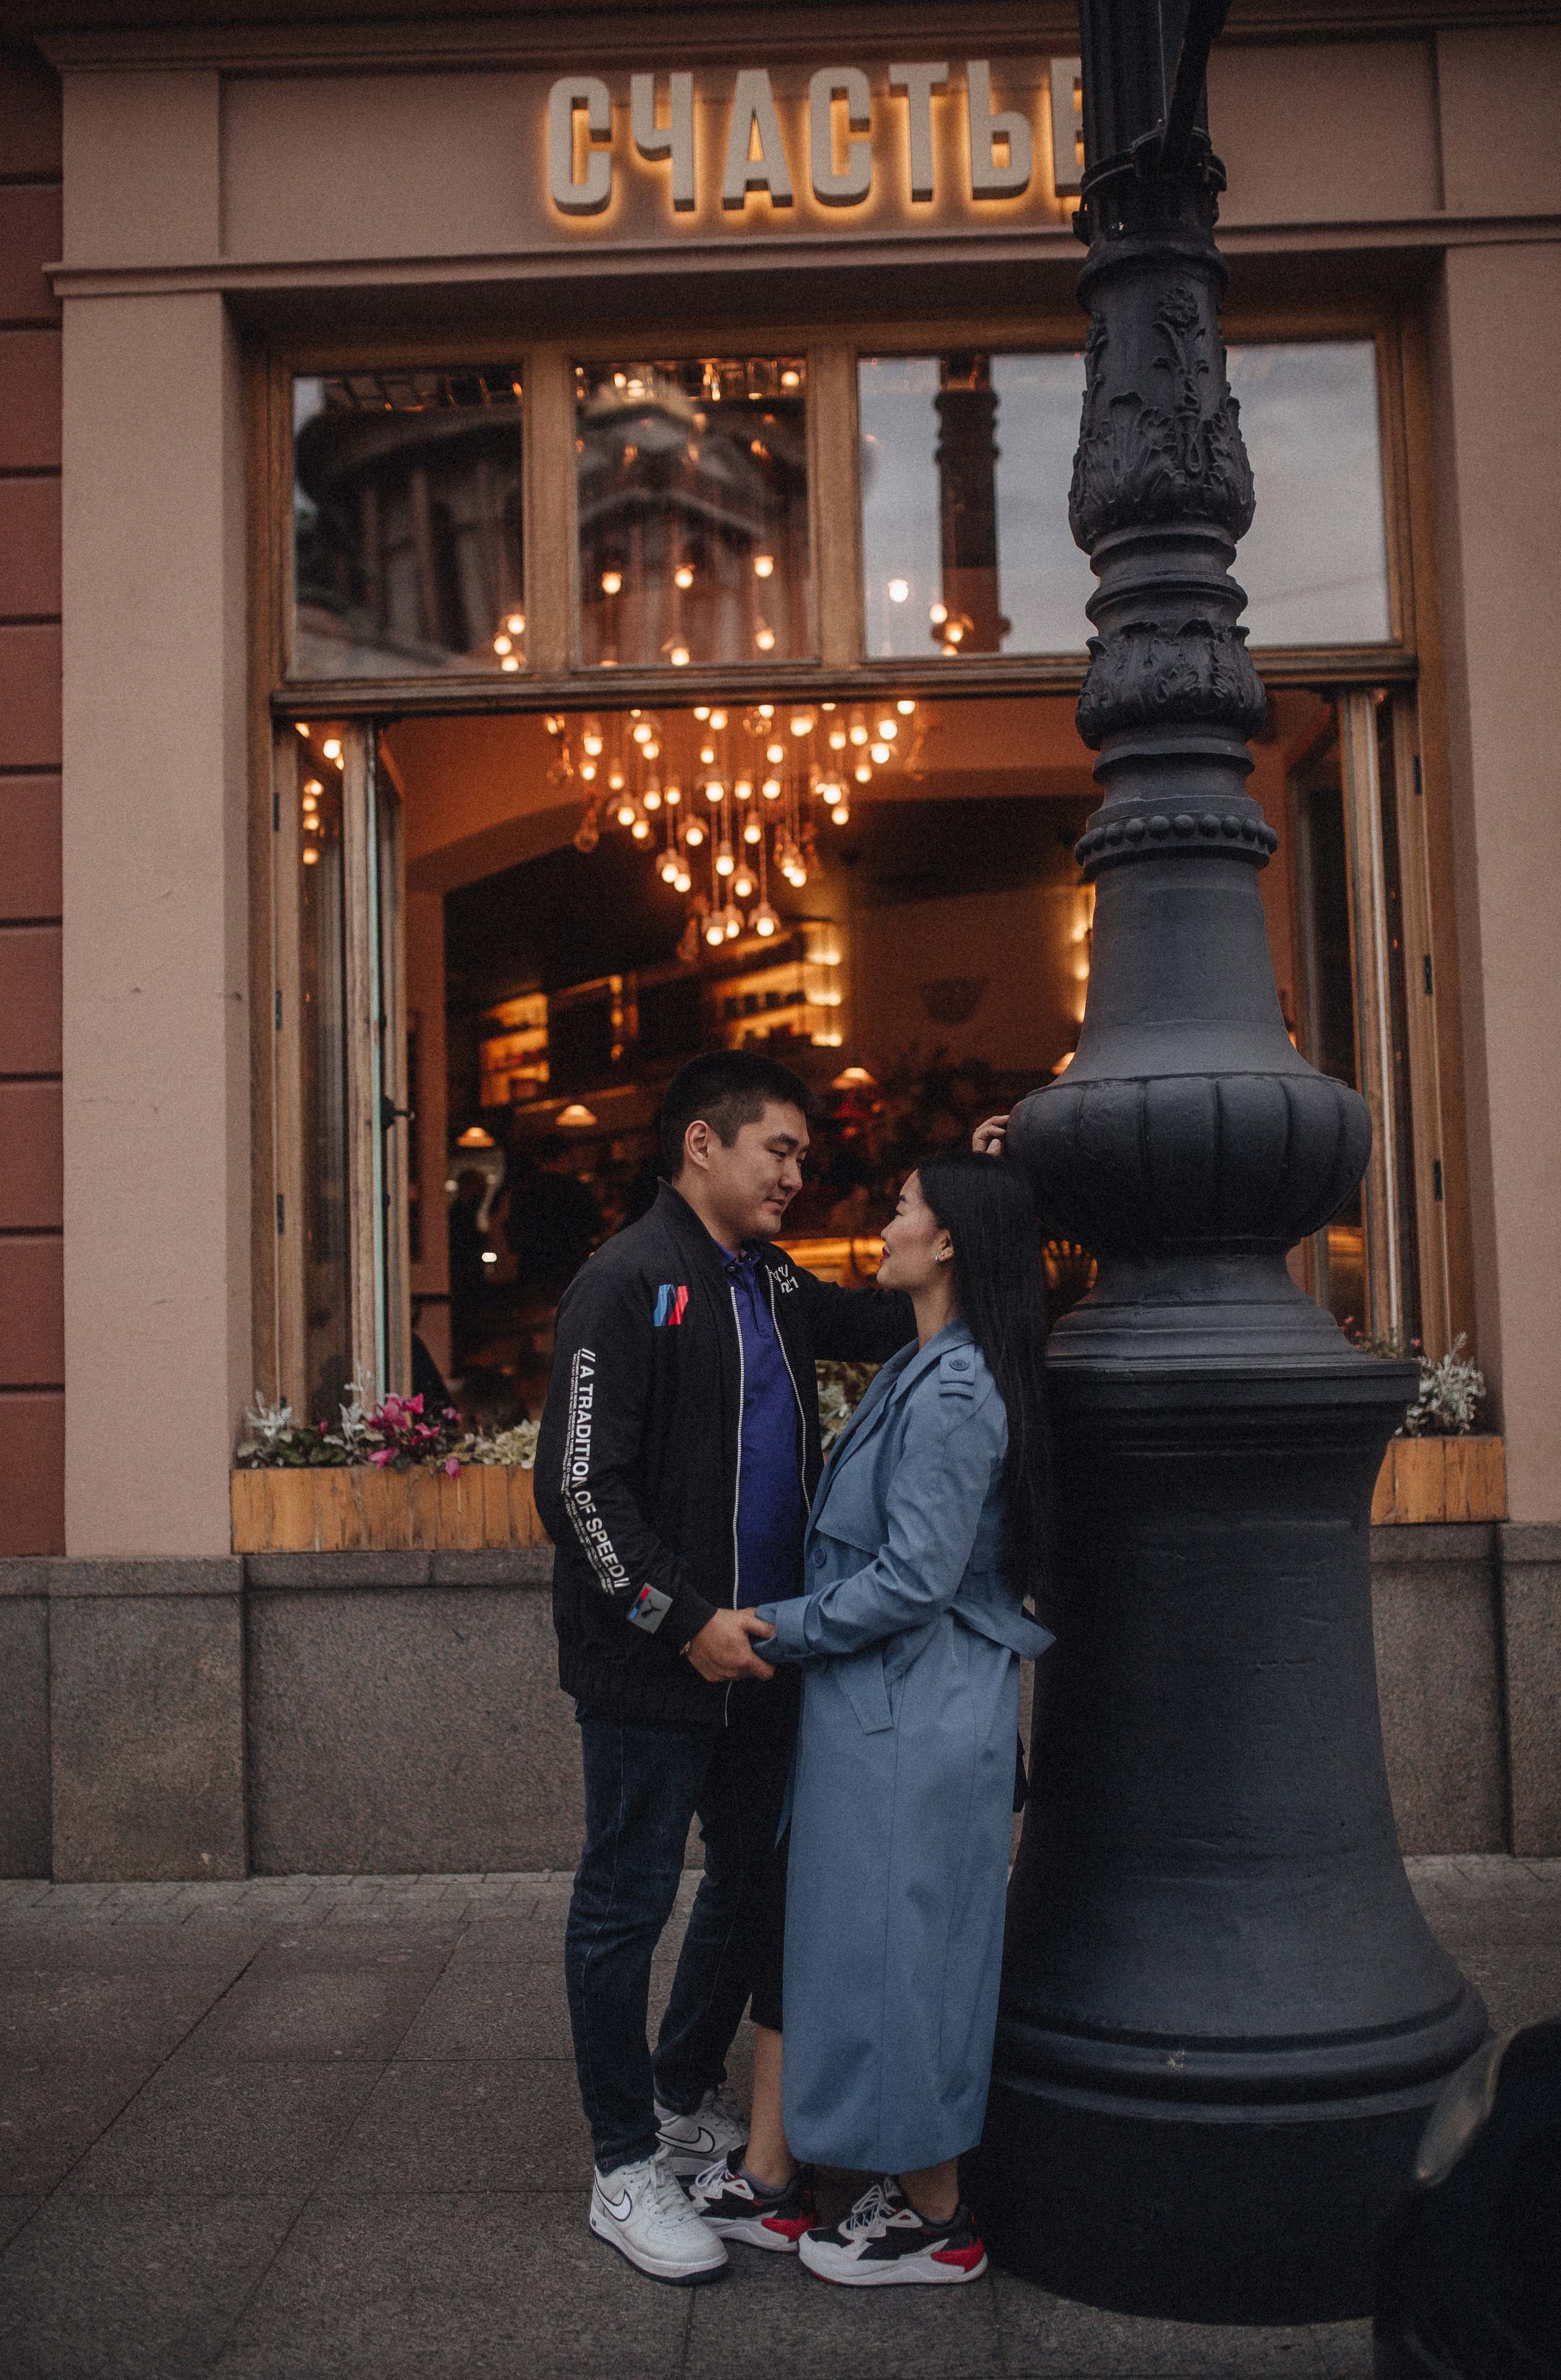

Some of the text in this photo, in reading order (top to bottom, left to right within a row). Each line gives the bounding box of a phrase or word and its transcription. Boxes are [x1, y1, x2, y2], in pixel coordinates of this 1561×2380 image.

[579, 1365, 594, 1378] A
[571, 1383, 593, 1488] TRADITION
[574, 1491, 596, 1513] OF
